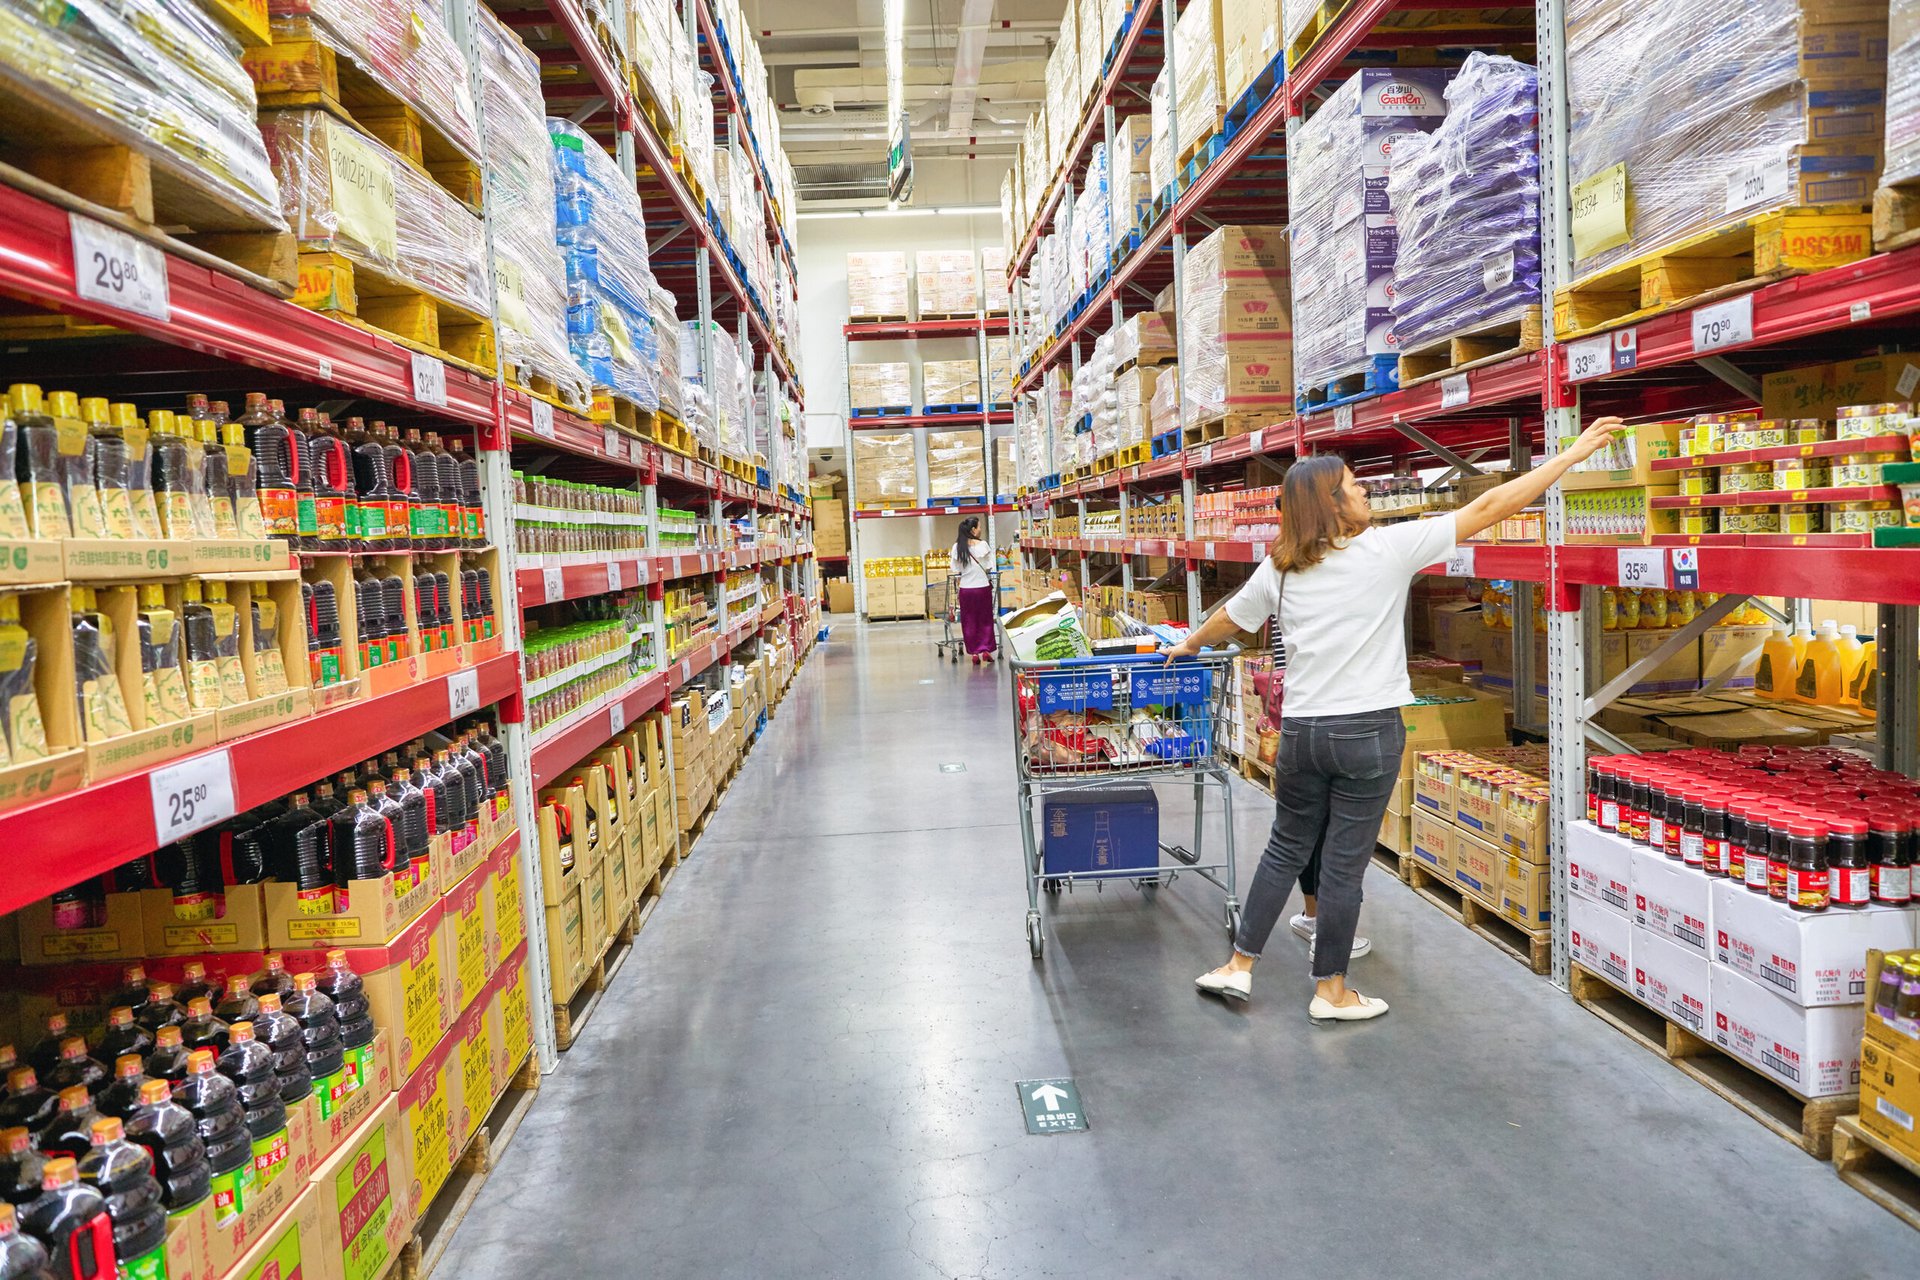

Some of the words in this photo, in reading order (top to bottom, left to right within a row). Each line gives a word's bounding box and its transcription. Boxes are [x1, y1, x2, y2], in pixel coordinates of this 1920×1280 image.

[1387, 85, 1412, 94] 百岁山
[1620, 355, 1630, 364] 日本
[1680, 575, 1692, 584] 韩国
[218, 1193, 230, 1207] 油
